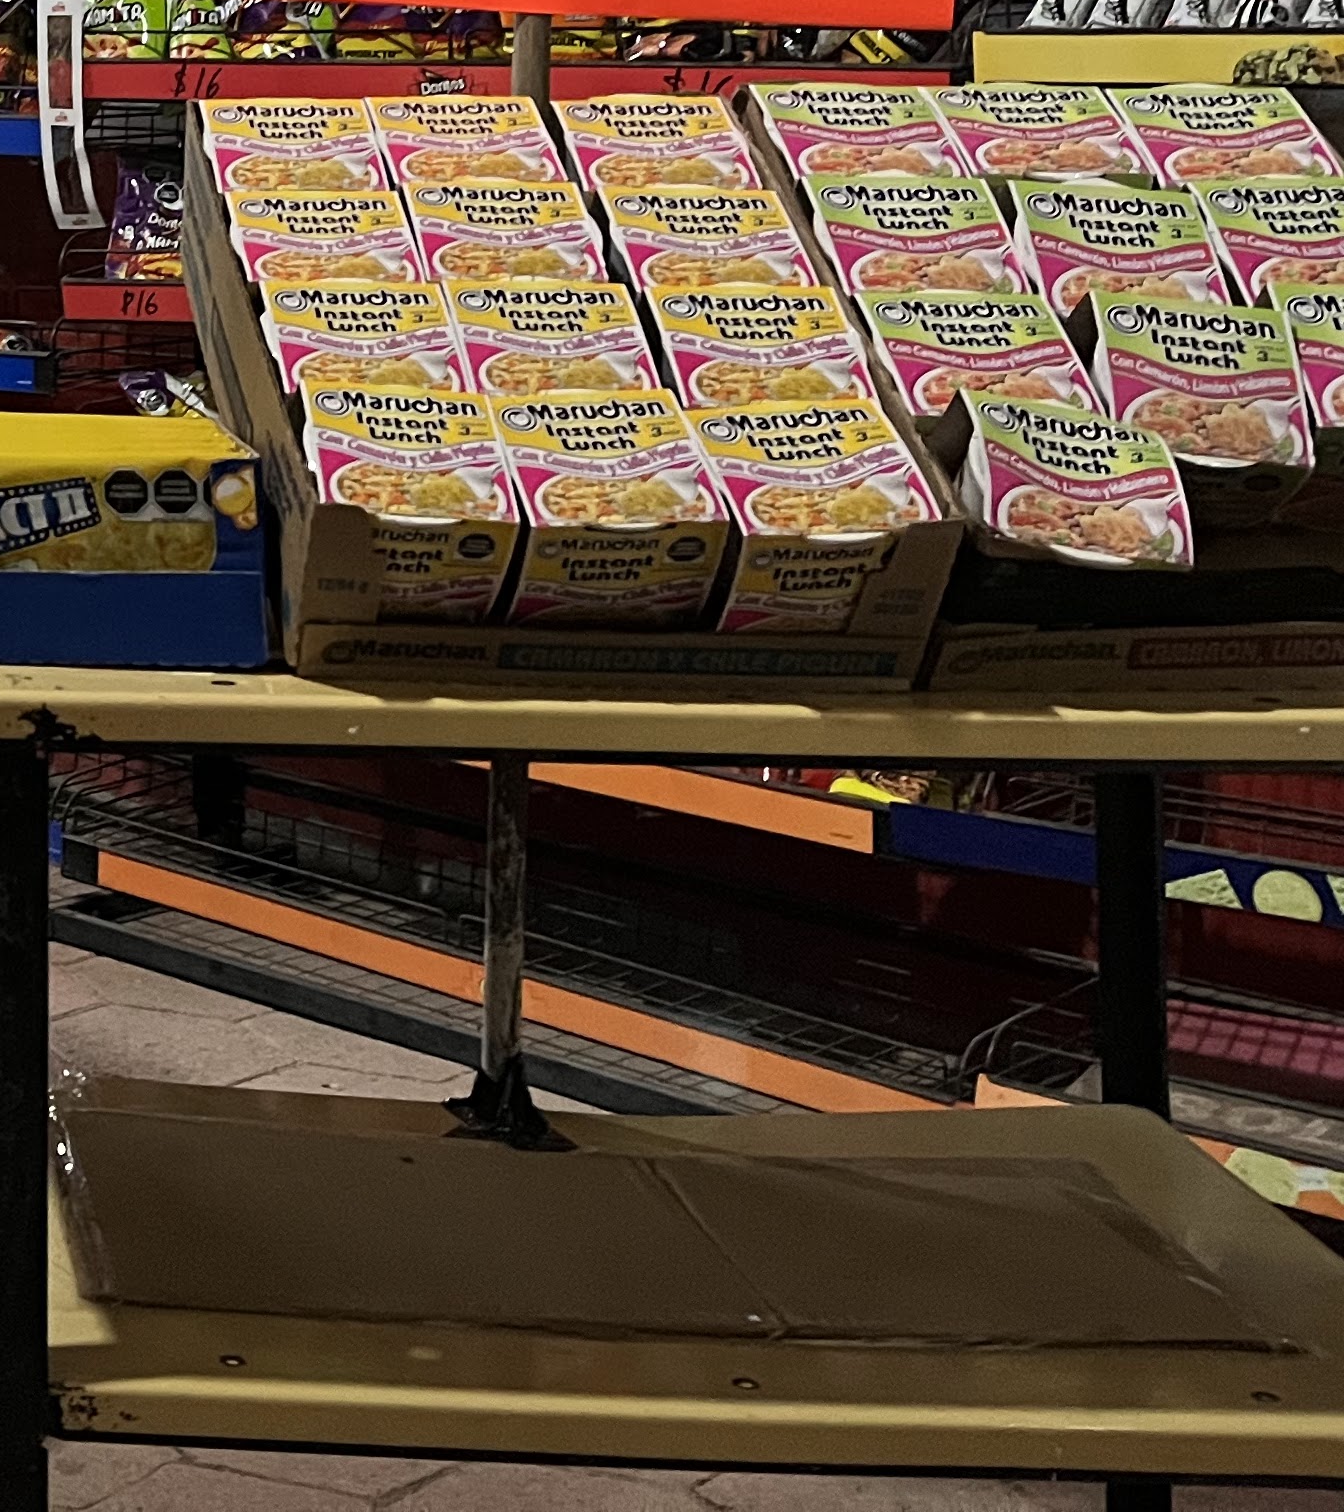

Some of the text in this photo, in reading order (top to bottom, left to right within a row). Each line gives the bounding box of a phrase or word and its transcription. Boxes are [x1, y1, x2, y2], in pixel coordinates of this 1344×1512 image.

[420, 78, 465, 96] Doritos
[1150, 92, 1279, 108] Maruchan
[237, 105, 354, 118] Maruchan
[1169, 107, 1258, 121] Instant
[249, 119, 329, 130] Instant
[1183, 118, 1255, 130] Lunch
[260, 129, 323, 139] Lunch
[442, 187, 566, 203] Maruchan
[846, 185, 978, 202] Maruchan
[455, 202, 541, 215] Instant
[862, 204, 954, 218] Instant
[466, 213, 534, 226] Lunch
[877, 217, 950, 230] Lunch
[691, 294, 825, 311] Maruchan
[705, 312, 798, 327] Instant
[1135, 305, 1276, 339] Maruchan
[719, 327, 794, 340] Lunch
[1151, 328, 1247, 354] Instant
[1164, 347, 1240, 370] Lunch
[345, 391, 477, 417] Maruchan
[529, 400, 666, 422] Maruchan
[356, 411, 449, 431] Instant
[1007, 404, 1149, 444] Maruchan
[369, 427, 442, 444] Lunch
[546, 423, 640, 439] Instant
[561, 437, 636, 451] Lunch
[1022, 429, 1119, 460] Instant
[1035, 448, 1111, 475] Lunch
[372, 528, 449, 543] aruchan
